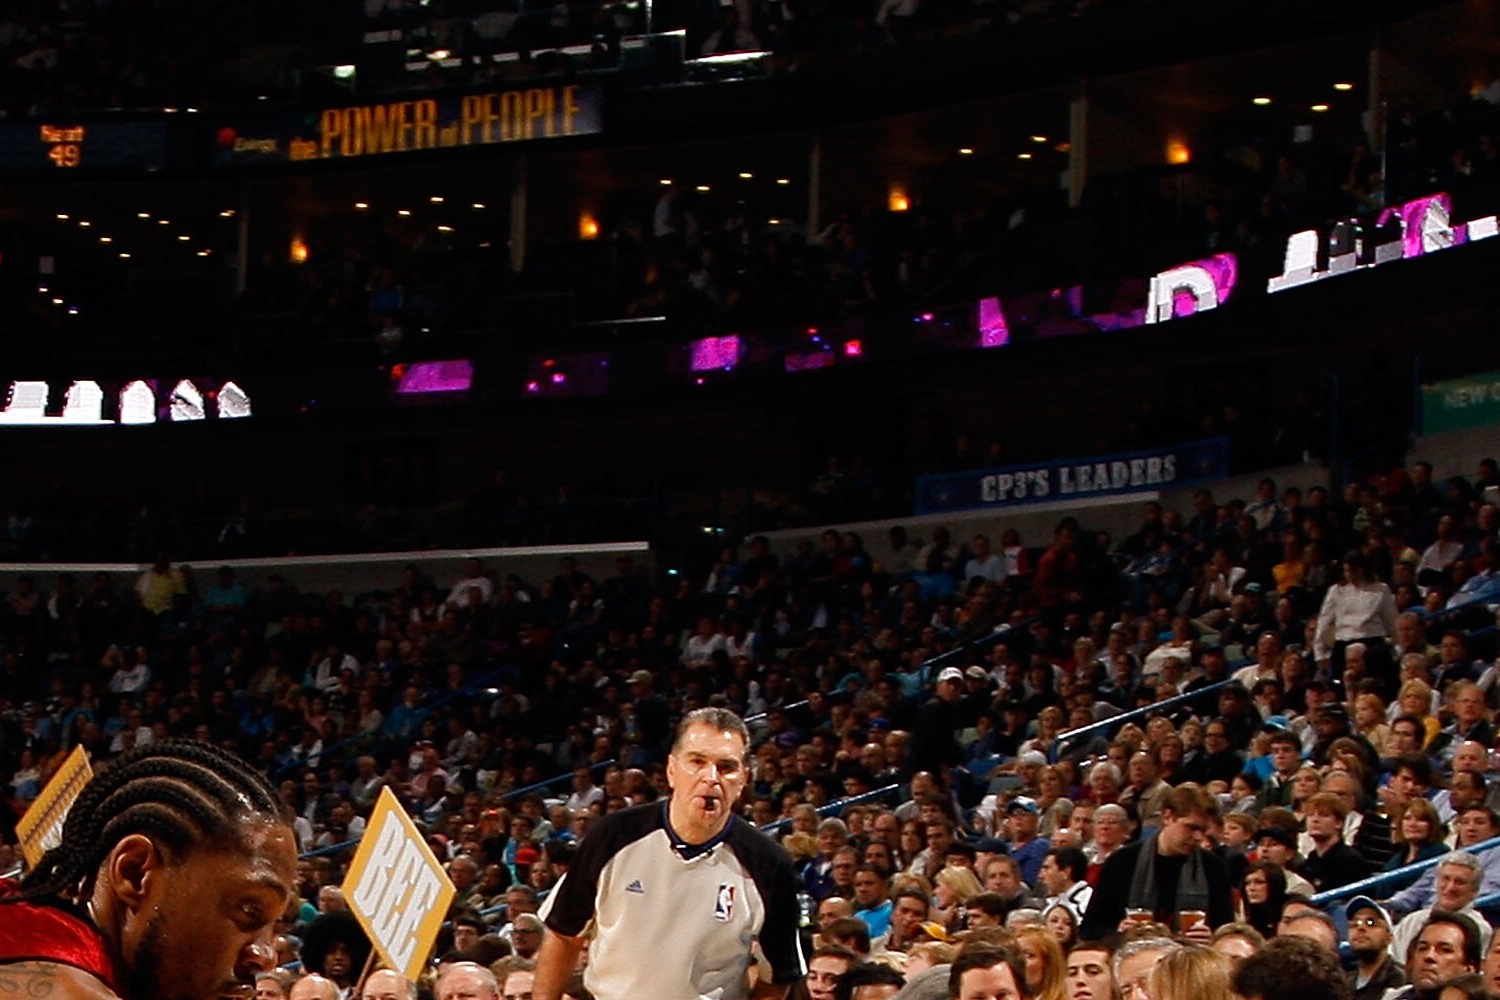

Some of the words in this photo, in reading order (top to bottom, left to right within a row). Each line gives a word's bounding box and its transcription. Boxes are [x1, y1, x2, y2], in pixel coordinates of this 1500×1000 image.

[321, 99, 438, 158] POWER
[461, 85, 580, 147] PEOPLE
[49, 145, 81, 168] 49
[981, 466, 1050, 502] CP3'S
[1059, 453, 1177, 495] LEADERS
[353, 809, 442, 973] BEE
